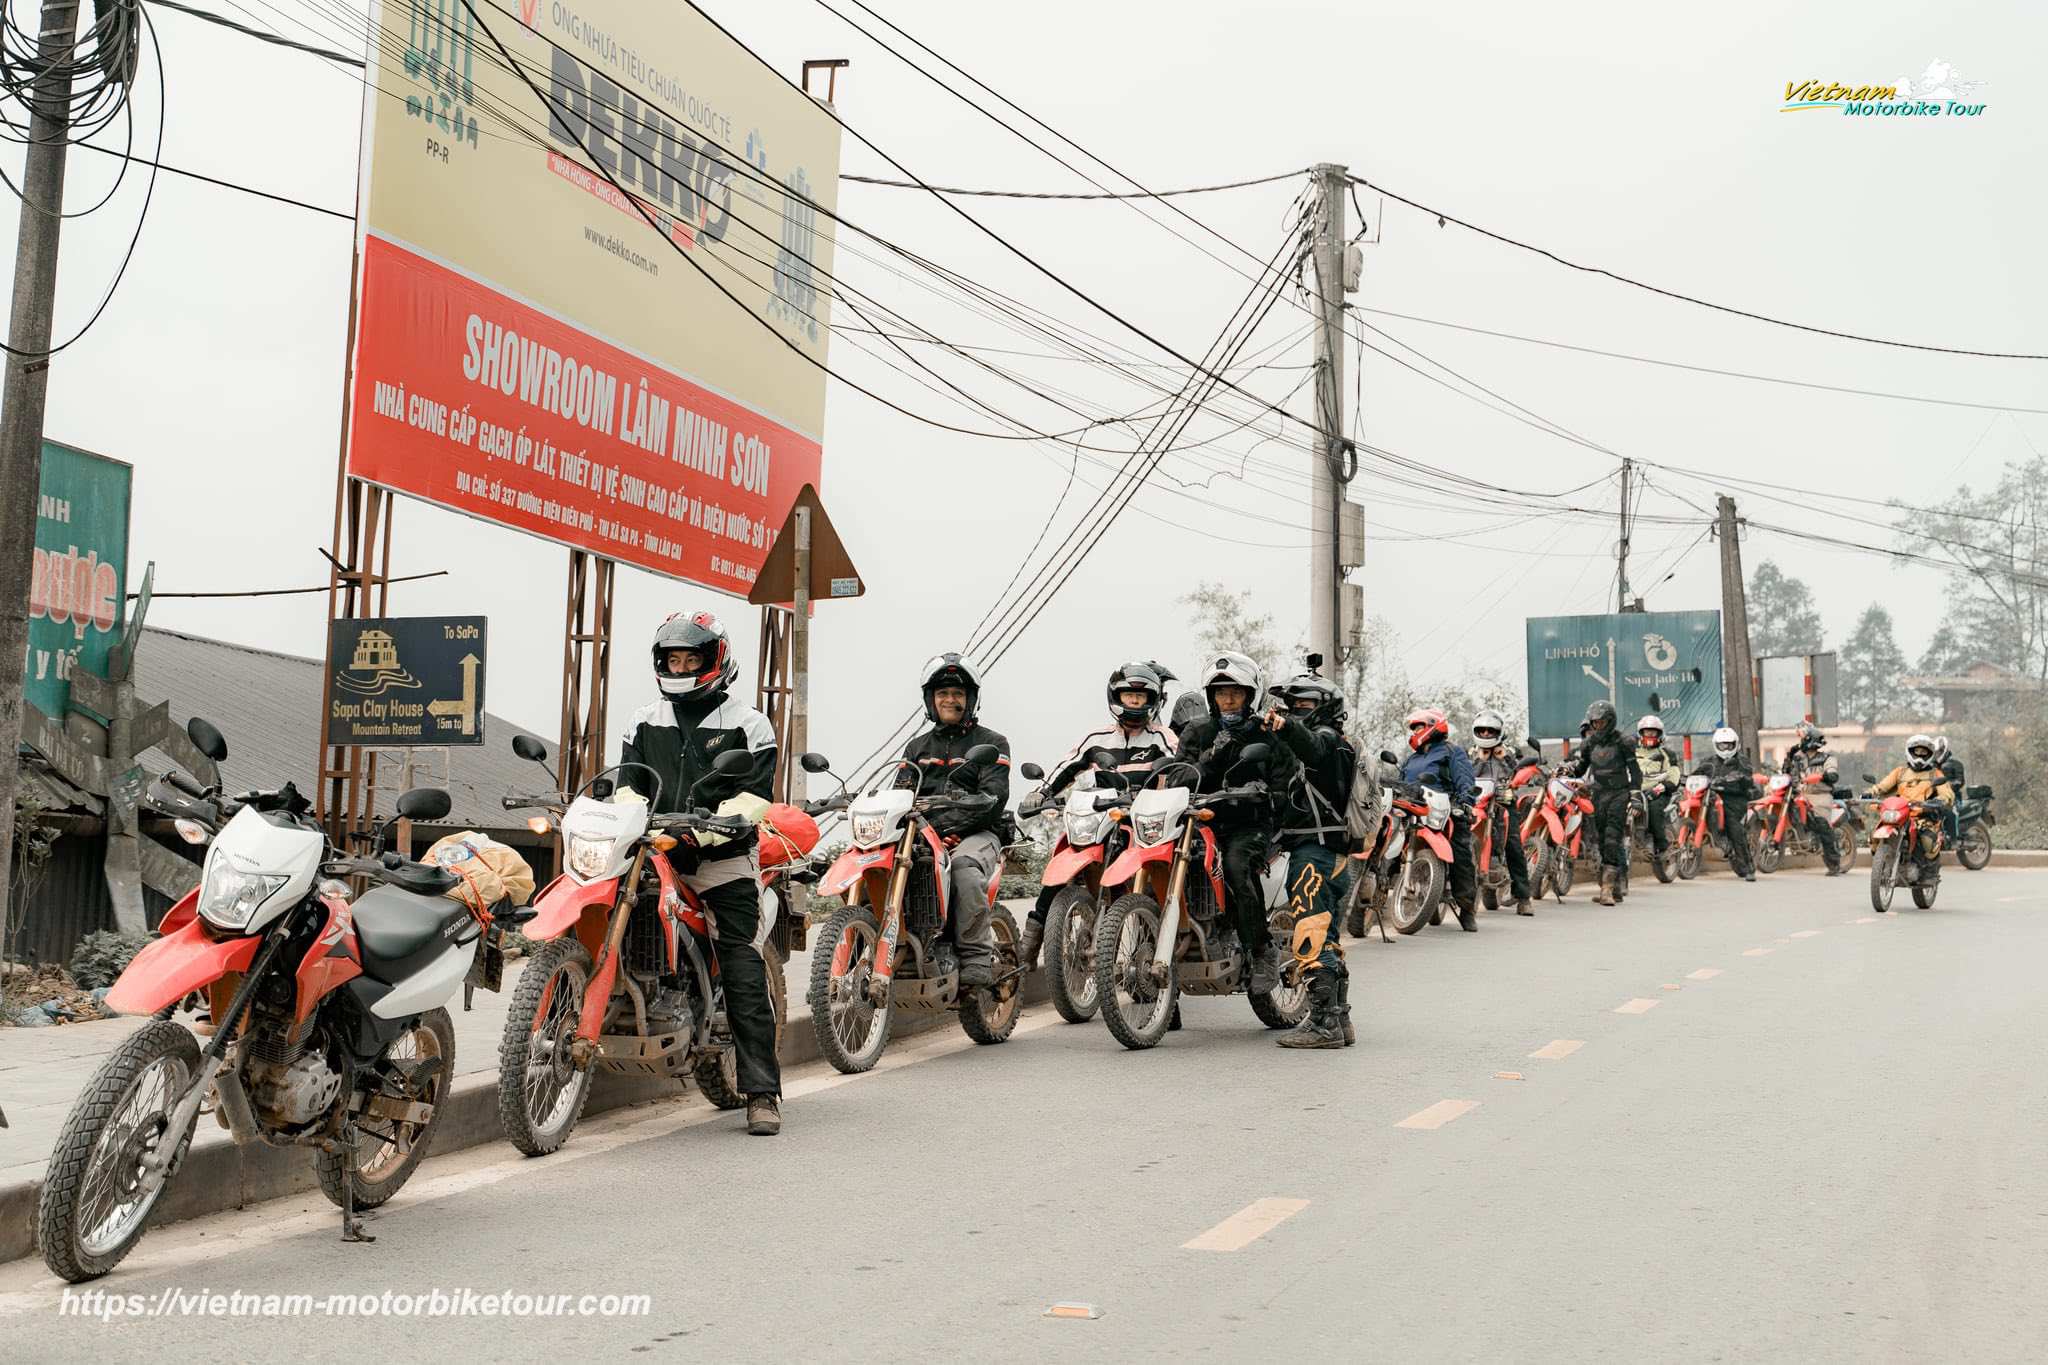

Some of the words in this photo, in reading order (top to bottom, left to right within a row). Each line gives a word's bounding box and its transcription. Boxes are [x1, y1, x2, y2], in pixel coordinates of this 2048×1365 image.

[426, 138, 449, 164] PP-R
[584, 226, 658, 276] www.dekko.com.vn
[463, 314, 617, 436] SHOWROOM
[620, 377, 670, 457] LÂM
[672, 406, 728, 481] MINH
[731, 432, 771, 497] SƠN
[374, 381, 405, 422] NHÀ
[409, 394, 447, 437] CUNG
[450, 403, 476, 446] CẤP
[479, 421, 513, 461] GẠCH
[515, 425, 532, 465] ỐP
[560, 449, 591, 488] THIẾT
[591, 463, 603, 499] BỊ
[605, 464, 620, 504] VỆ
[620, 474, 646, 507] SINH
[647, 483, 667, 515] CAO
[668, 485, 688, 521] CẤP
[689, 495, 702, 529] VÀ
[726, 512, 751, 545] NƯỚC
[752, 516, 766, 549] SỐ
[37, 494, 71, 523] NH
[489, 478, 502, 502] SỐ
[501, 486, 516, 507] 337
[629, 529, 639, 546] PA
[444, 624, 454, 640] To
[456, 624, 479, 640] SaPa
[1545, 647, 1576, 660] LINH
[1624, 676, 1650, 688] Sapa
[1654, 672, 1680, 688] Jade
[332, 700, 360, 722] Sapa
[362, 699, 387, 721] Clay
[390, 700, 424, 717] House
[1660, 696, 1680, 709] km
[352, 722, 390, 736] Mountain
[392, 723, 422, 736] Retreat
[436, 718, 452, 730] 15m
